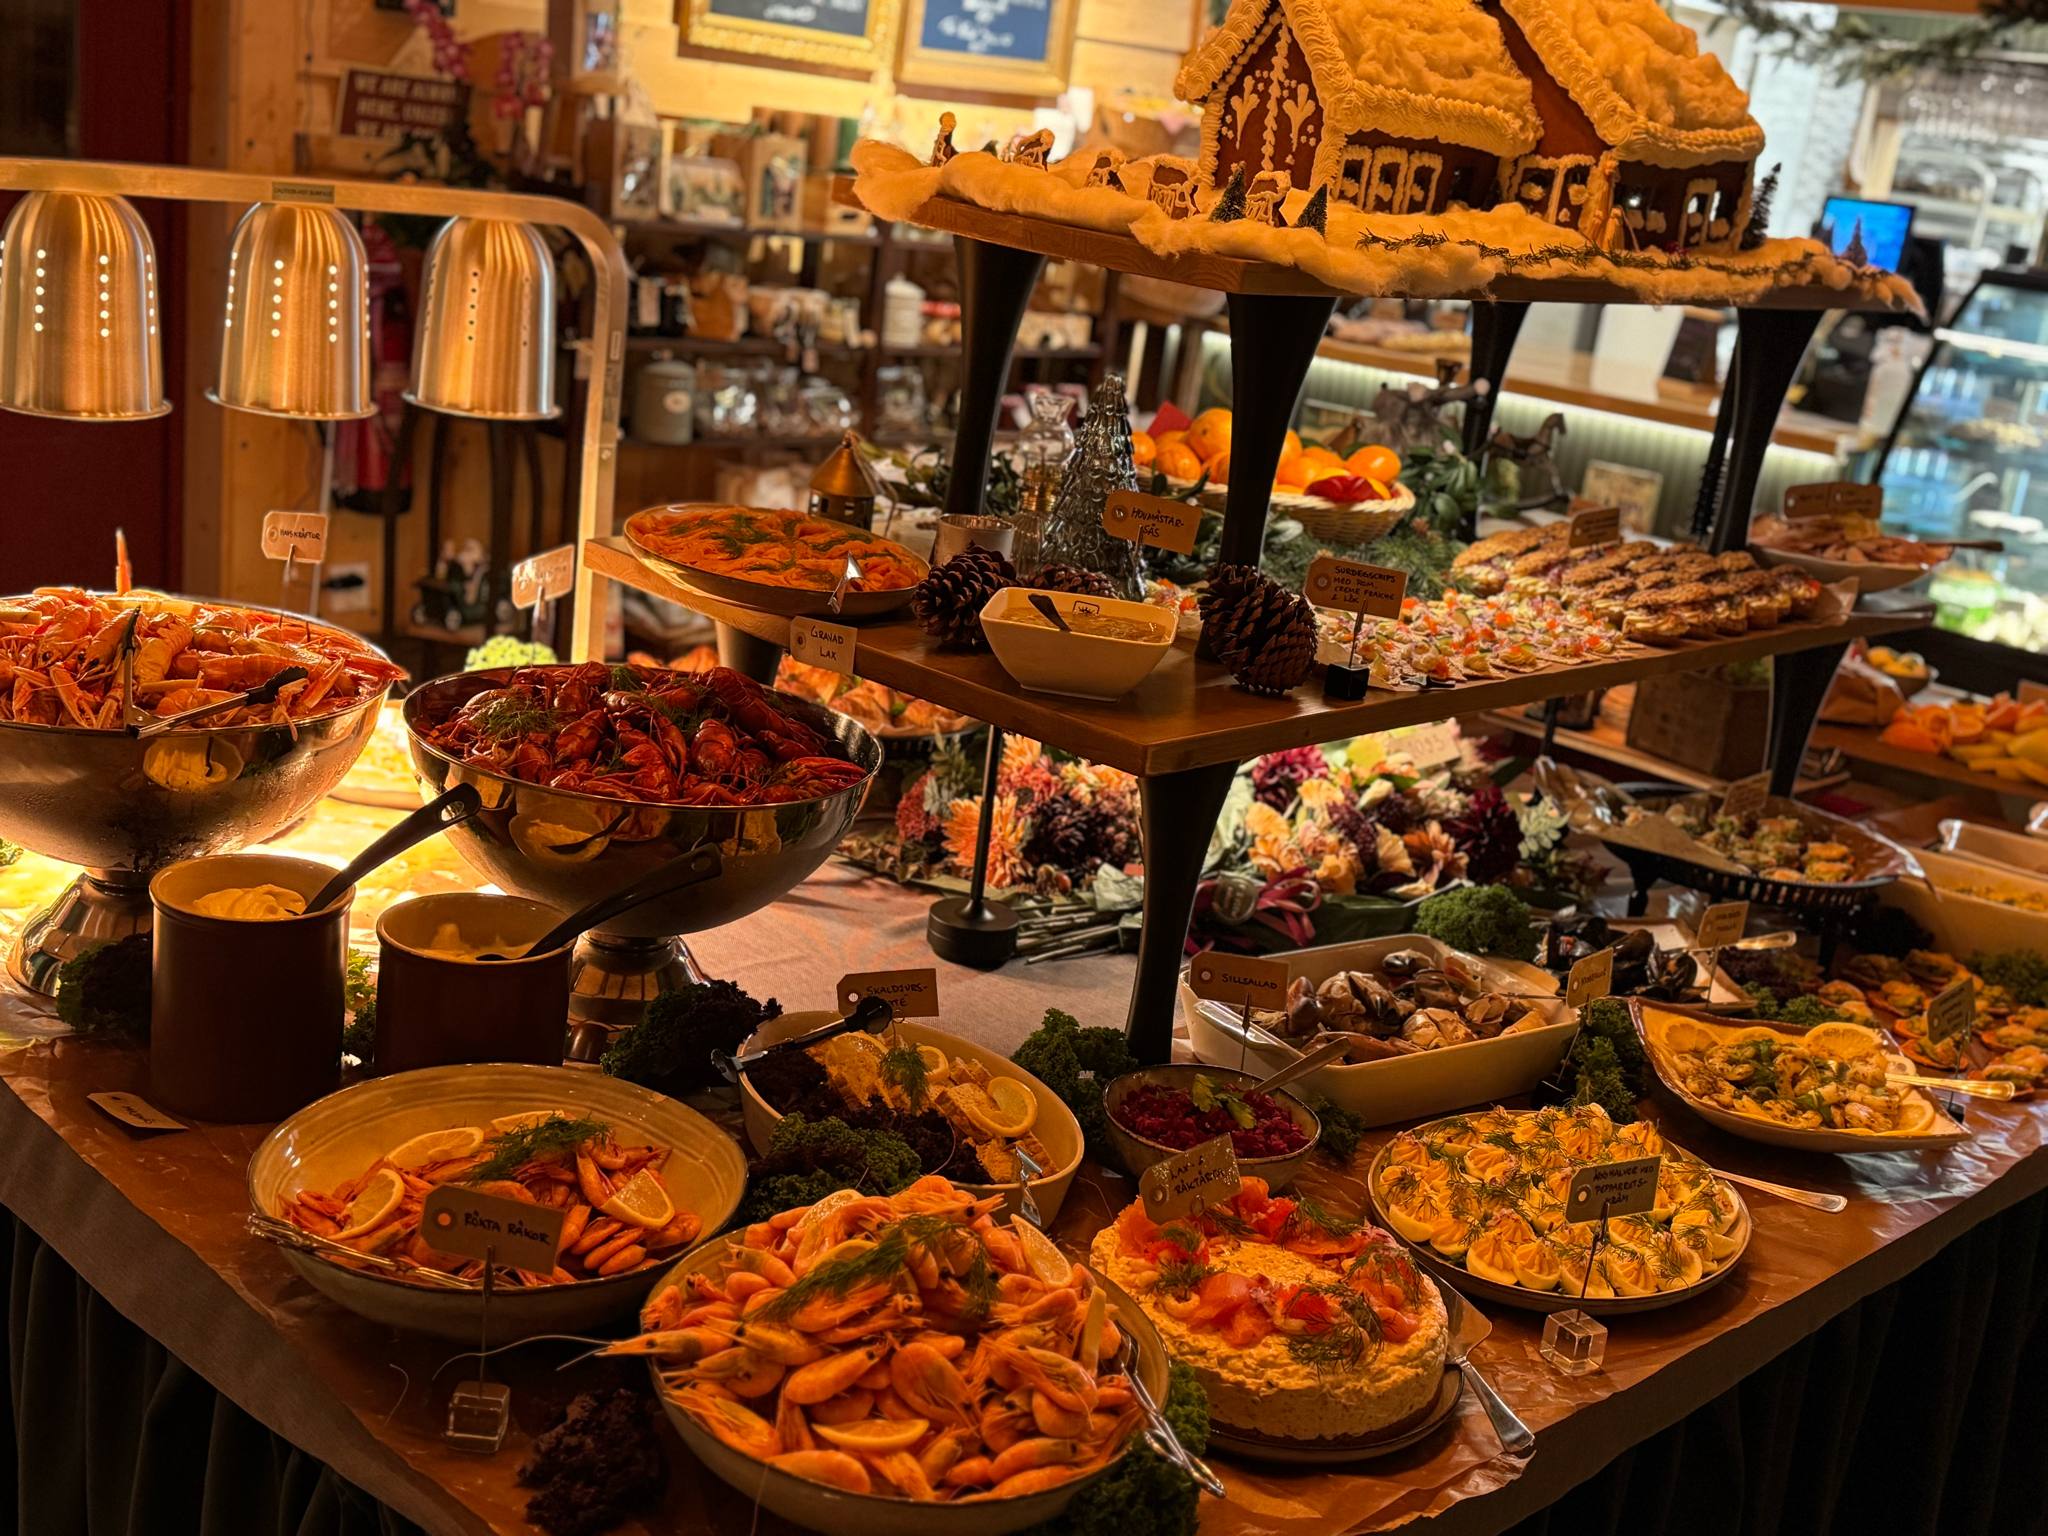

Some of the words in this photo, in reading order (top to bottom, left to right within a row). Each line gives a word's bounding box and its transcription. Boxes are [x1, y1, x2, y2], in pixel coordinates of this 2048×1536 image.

[811, 625, 844, 645] GRAVAD
[819, 647, 837, 661] LAX
[1222, 973, 1279, 990] SILLSALLAD
